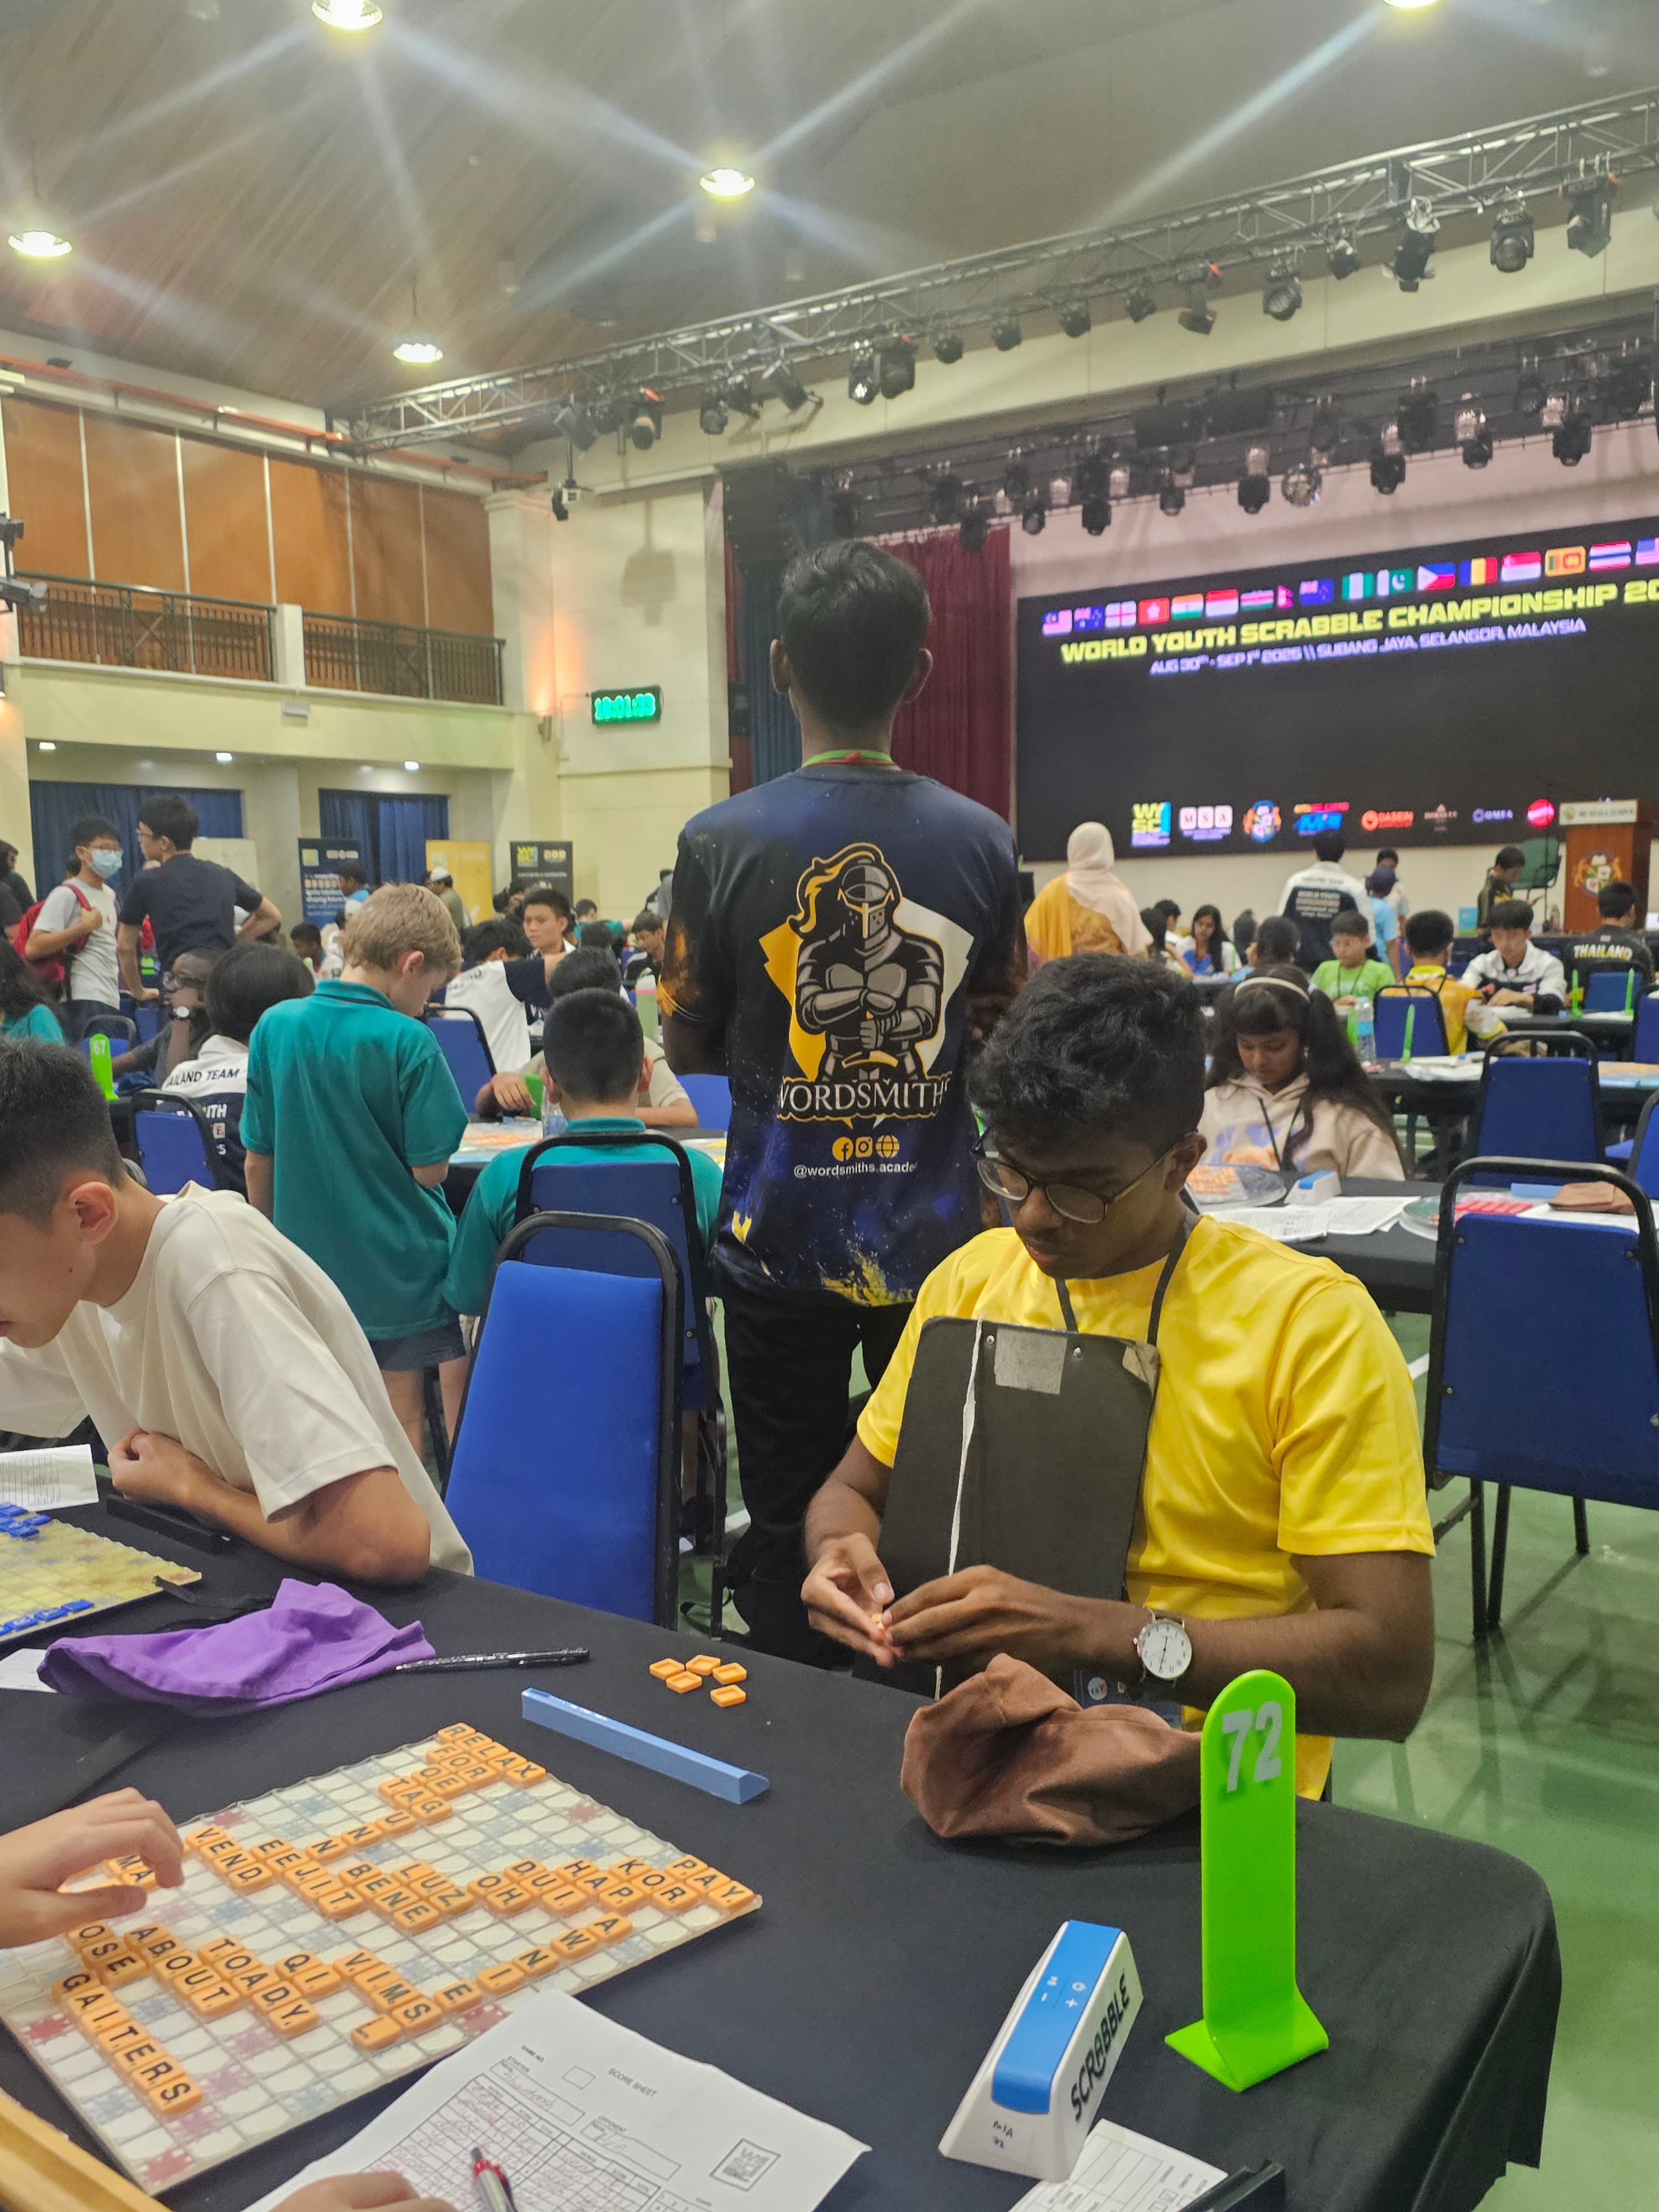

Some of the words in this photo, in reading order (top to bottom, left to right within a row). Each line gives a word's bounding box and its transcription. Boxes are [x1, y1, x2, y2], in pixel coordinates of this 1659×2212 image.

[1061, 636, 1147, 662] WORLD
[1151, 625, 1237, 653] YOUTH
[1240, 609, 1384, 643] SCRABBLE
[1389, 583, 1618, 628] CHAMPIONSHIP
[1150, 659, 1180, 675] AUG
[1217, 651, 1246, 669] SEP
[1261, 645, 1302, 664] 2025
[1317, 639, 1378, 657] SUBANG
[1507, 617, 1587, 638] MALAYSIA
[1573, 943, 1633, 962] THAILAND
[206, 1068, 240, 1081] TEAM
[435, 1745, 487, 1777] FOR
[444, 1725, 538, 1778] RELAX
[1222, 1700, 1282, 1793] 72
[388, 1778, 444, 1814] TAG
[196, 1827, 263, 1884] VEND
[258, 1839, 355, 1905] EEJIT
[347, 1863, 430, 1922] BENE
[400, 1863, 466, 1907] LUZ
[512, 1860, 575, 1901] DUI
[564, 1860, 634, 1903] HAP
[618, 1859, 686, 1904] KOR
[672, 1858, 745, 1902] PAY
[131, 1925, 231, 2002] ABOUT
[208, 1938, 310, 2021] TOADY
[283, 1954, 330, 1984] QI
[345, 1952, 431, 2023] VIMS
[62, 1973, 191, 2102] GAITERS
[1071, 1968, 1130, 2122] SCRABBLE
[507, 2055, 531, 2074] STARTER
[608, 2067, 633, 2086] SCORE
[632, 2081, 658, 2098] SHEET
[597, 2115, 627, 2133] OPPONENT
